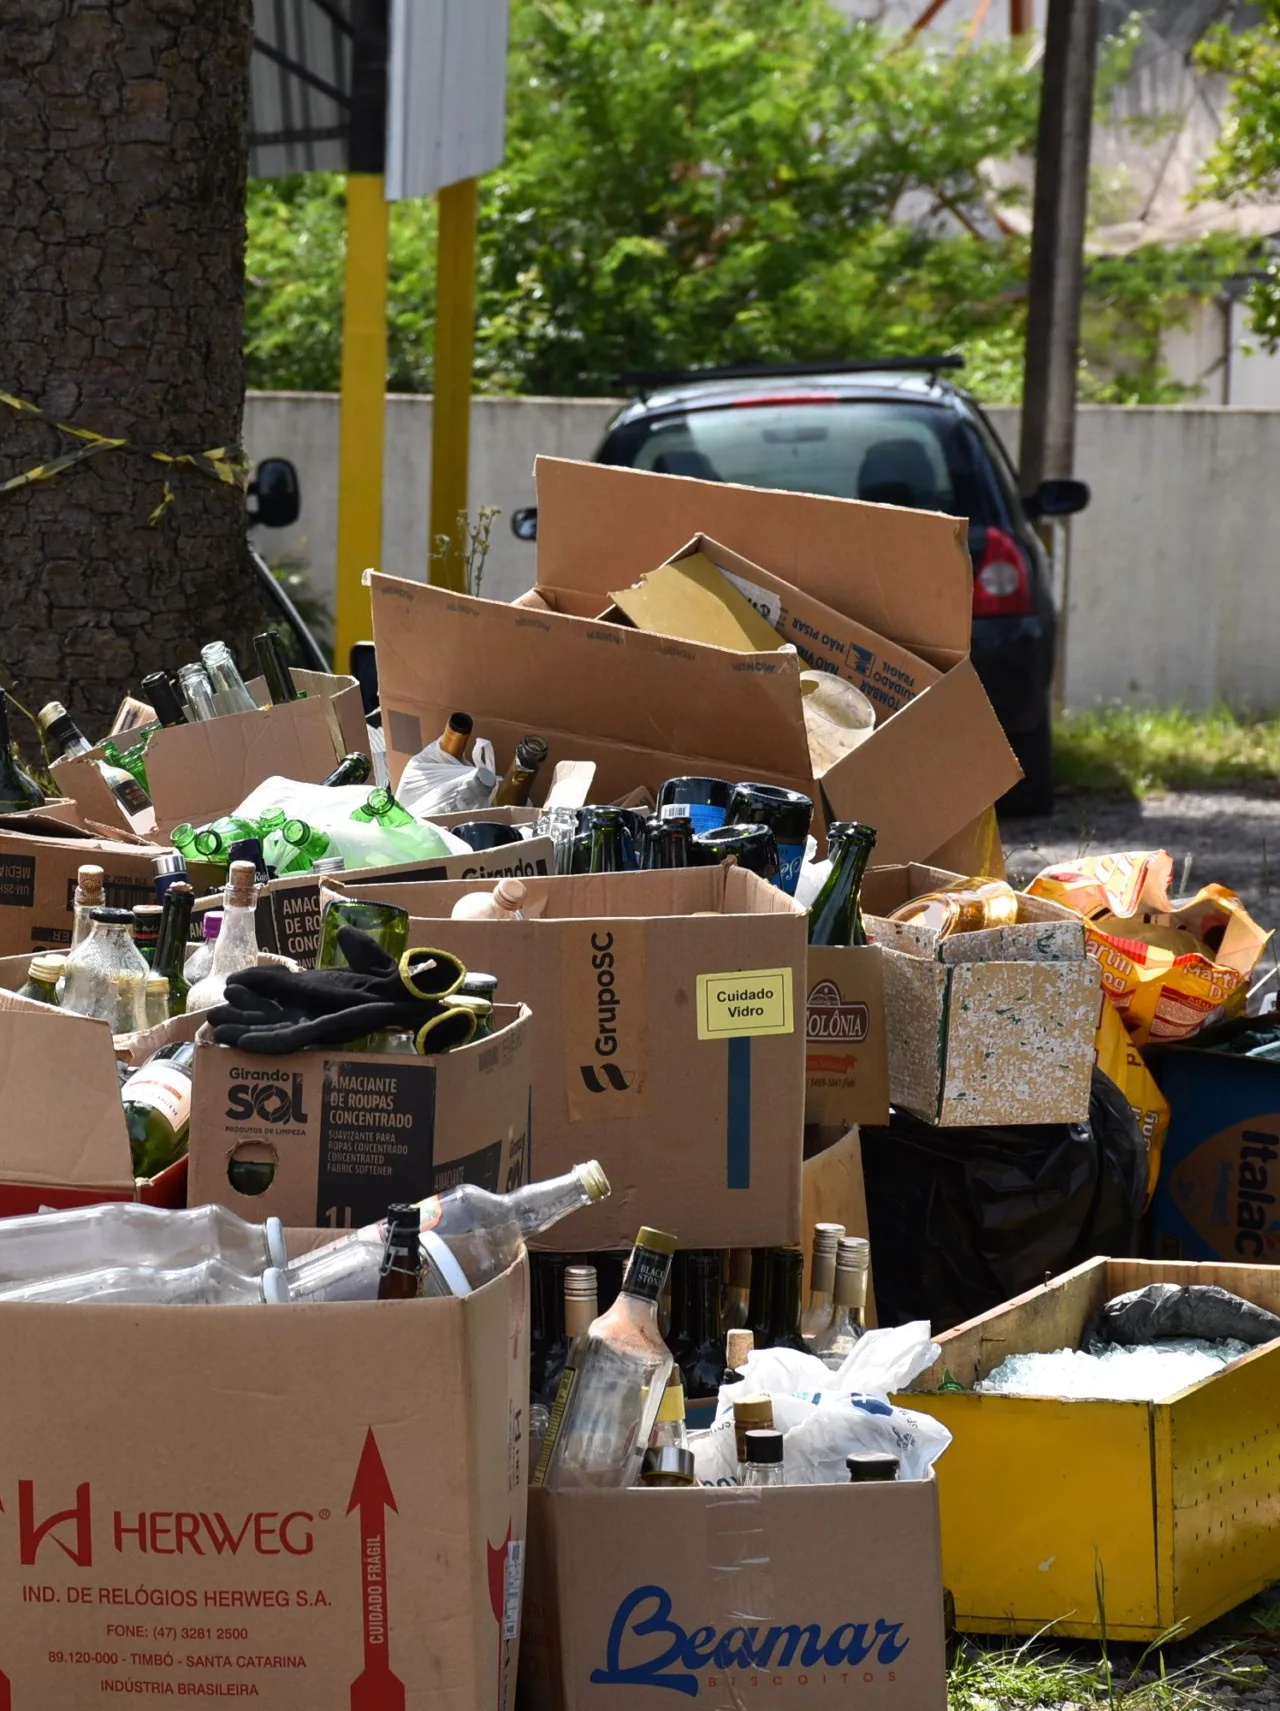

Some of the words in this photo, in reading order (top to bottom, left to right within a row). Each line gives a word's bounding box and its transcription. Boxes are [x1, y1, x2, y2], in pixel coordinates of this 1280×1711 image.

[284, 916, 302, 935] DE
[1086, 931, 1133, 977] artin
[1102, 972, 1127, 992] og
[590, 931, 620, 1057] GrupoSC
[716, 987, 774, 1003] Cuidado
[728, 1005, 764, 1018] Vidro
[229, 1067, 290, 1082] Girando
[330, 1075, 398, 1093] AMACIANTE
[330, 1092, 345, 1107] DE
[348, 1093, 394, 1110] ROUPAS
[329, 1110, 413, 1129] CONCENTRADO
[225, 1126, 262, 1134] PRODUTOS
[275, 1128, 307, 1136] LIMPEZA
[328, 1130, 374, 1142] SUAVIZANTE
[375, 1132, 396, 1143] PARA
[328, 1141, 352, 1151] ROPAS
[354, 1142, 408, 1155] CONCENTRADO
[327, 1153, 384, 1165] CONCENTRATED
[327, 1163, 353, 1174] FABRIC
[354, 1164, 393, 1176] SOFTENER
[1234, 1129, 1280, 1258] Italac
[114, 1511, 314, 1556] HERWEG
[363, 1533, 382, 1581] FRÁGIL
[22, 1585, 61, 1604] IND.
[67, 1586, 93, 1604] DE
[98, 1583, 198, 1607] RELÓGIOS
[204, 1590, 290, 1608] HERWEG
[296, 1590, 332, 1608] S.A.
[368, 1585, 384, 1644] CUIDADO
[106, 1624, 149, 1639] FONE:
[152, 1626, 178, 1641] (47)
[181, 1627, 212, 1640] 3281
[216, 1628, 249, 1641] 2500
[589, 1584, 911, 1697] Beamar
[47, 1651, 119, 1665] 89.120-000
[130, 1649, 174, 1667] TIMBÓ
[186, 1655, 233, 1668] SANTA
[235, 1655, 307, 1669] CATARINA
[100, 1676, 174, 1695] INDÚSTRIA
[177, 1683, 259, 1697] BRASILEIRA
[708, 1671, 897, 1688] BISCOITOS
